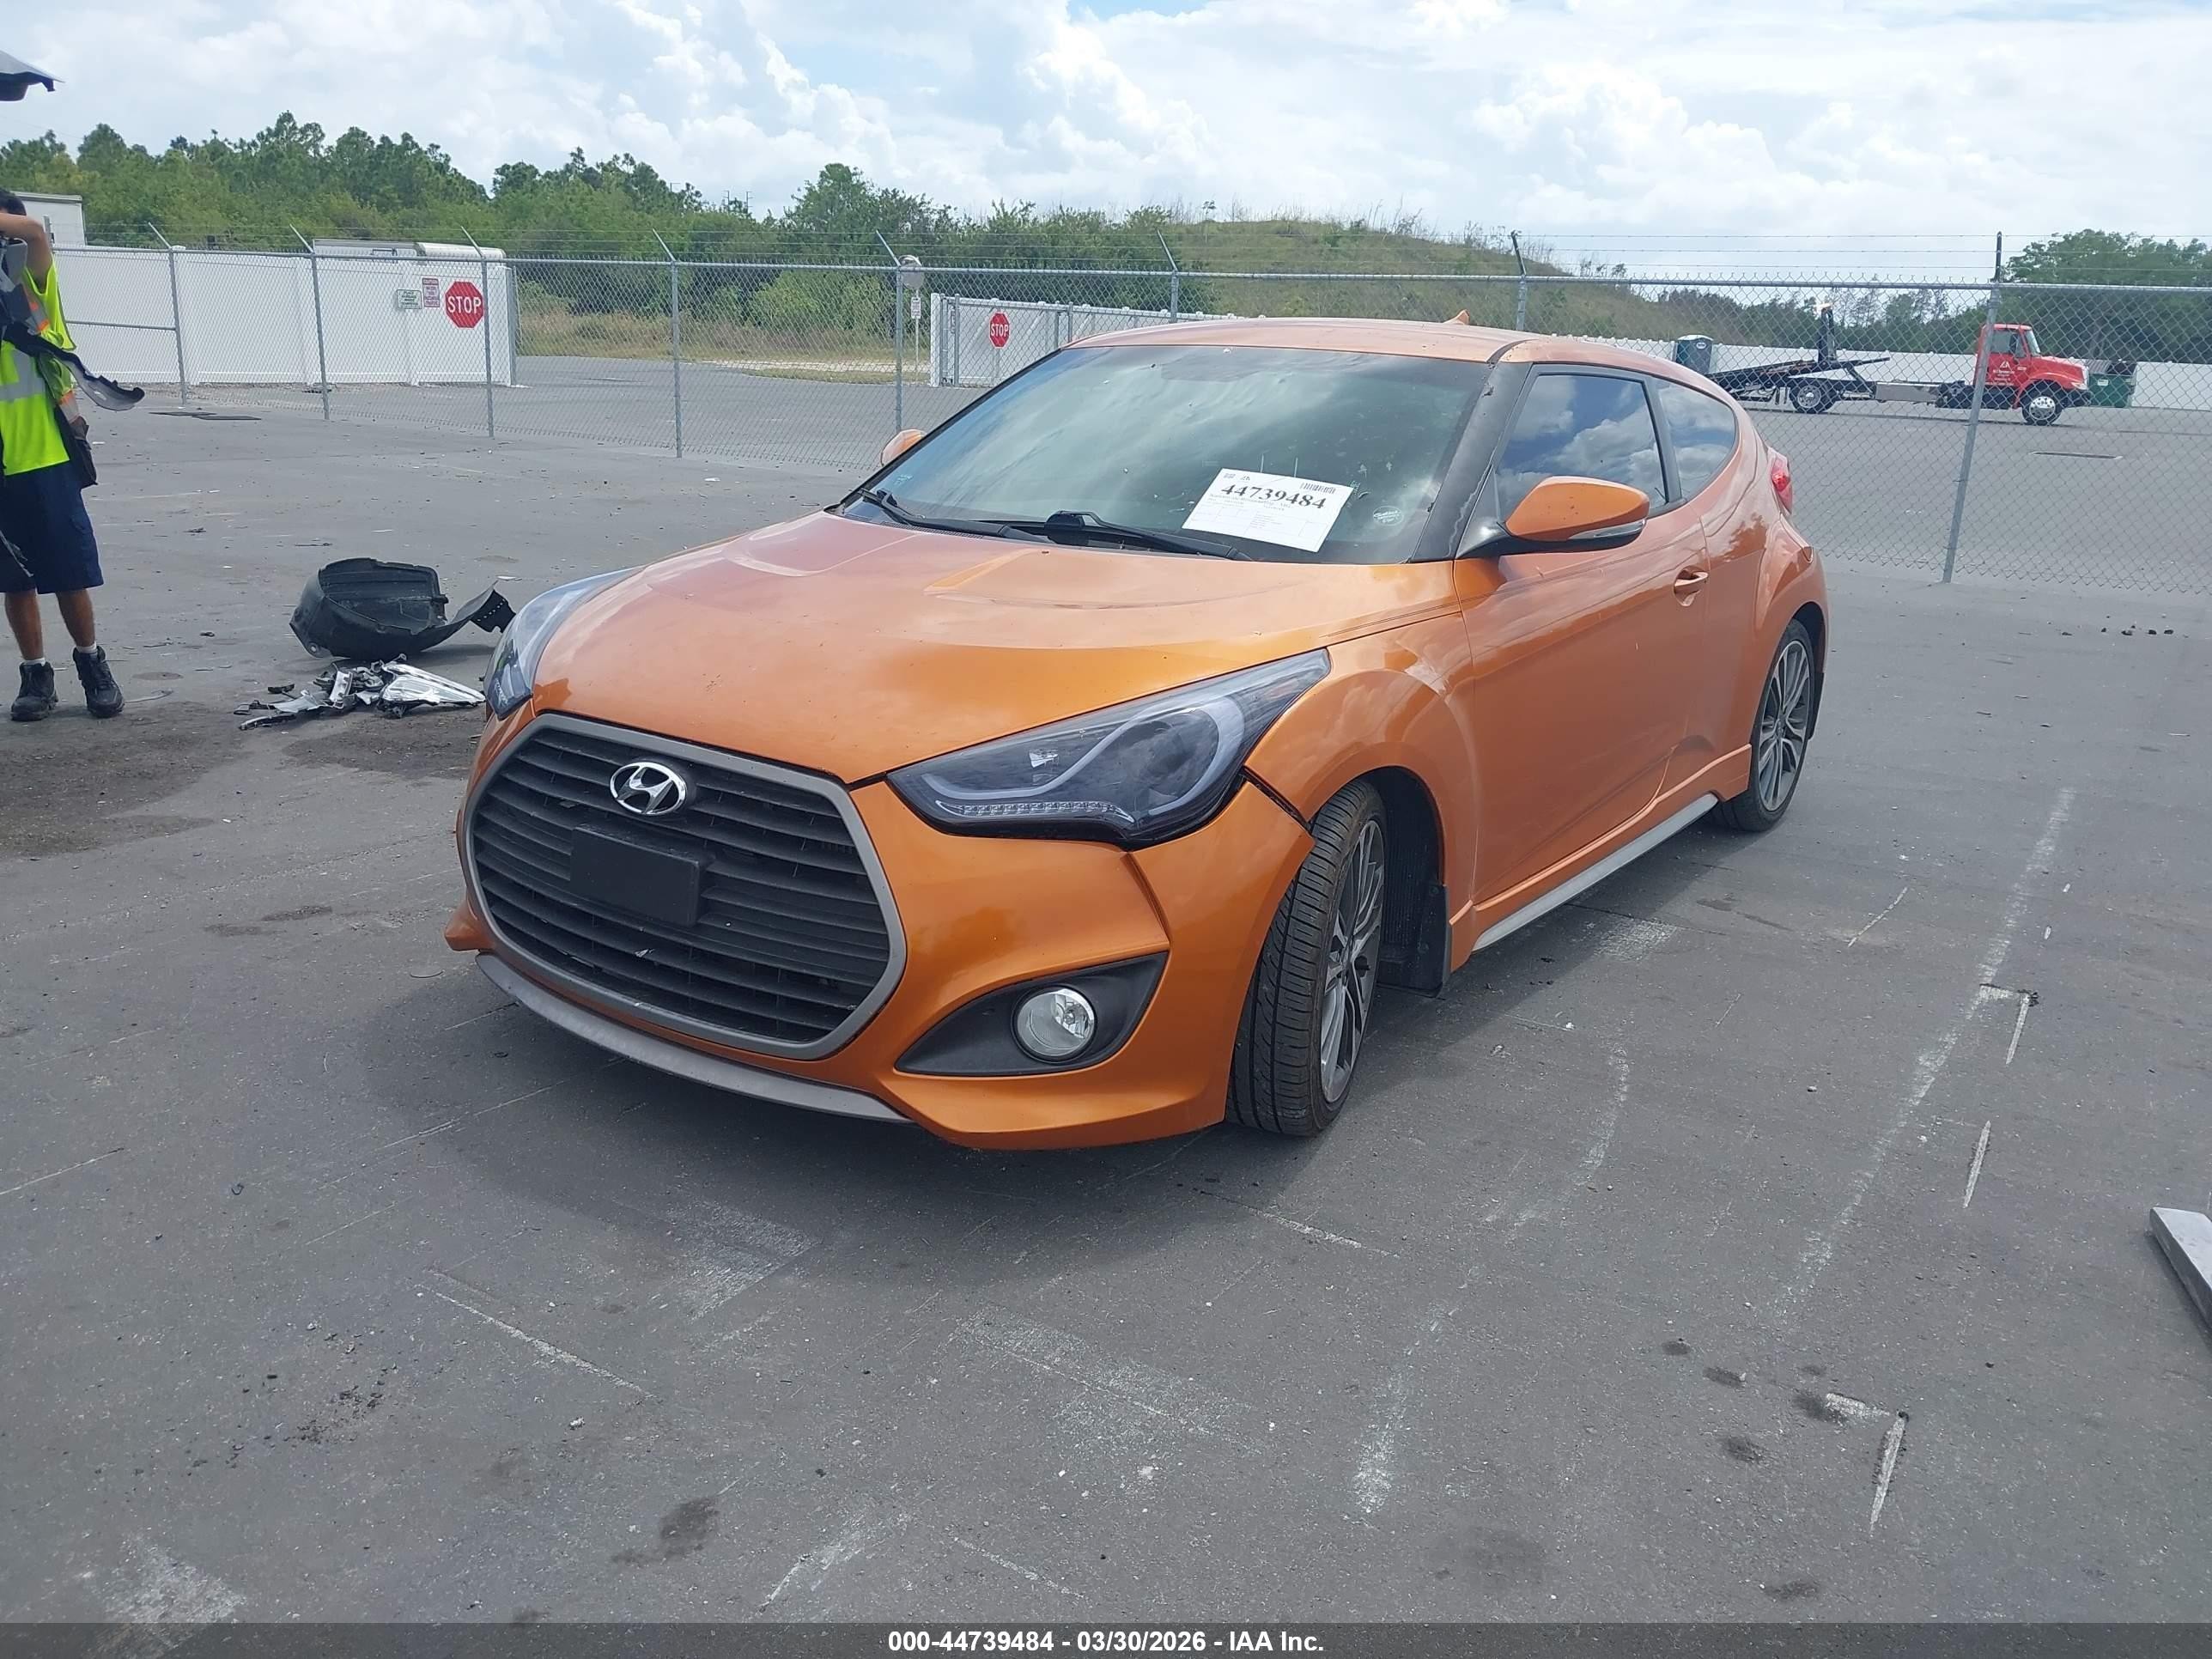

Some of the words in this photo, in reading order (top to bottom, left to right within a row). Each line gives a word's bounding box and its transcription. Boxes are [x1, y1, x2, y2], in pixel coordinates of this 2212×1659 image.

[447, 295, 482, 314] STOP
[990, 324, 1009, 337] STOP
[1221, 483, 1328, 510] 44739484
